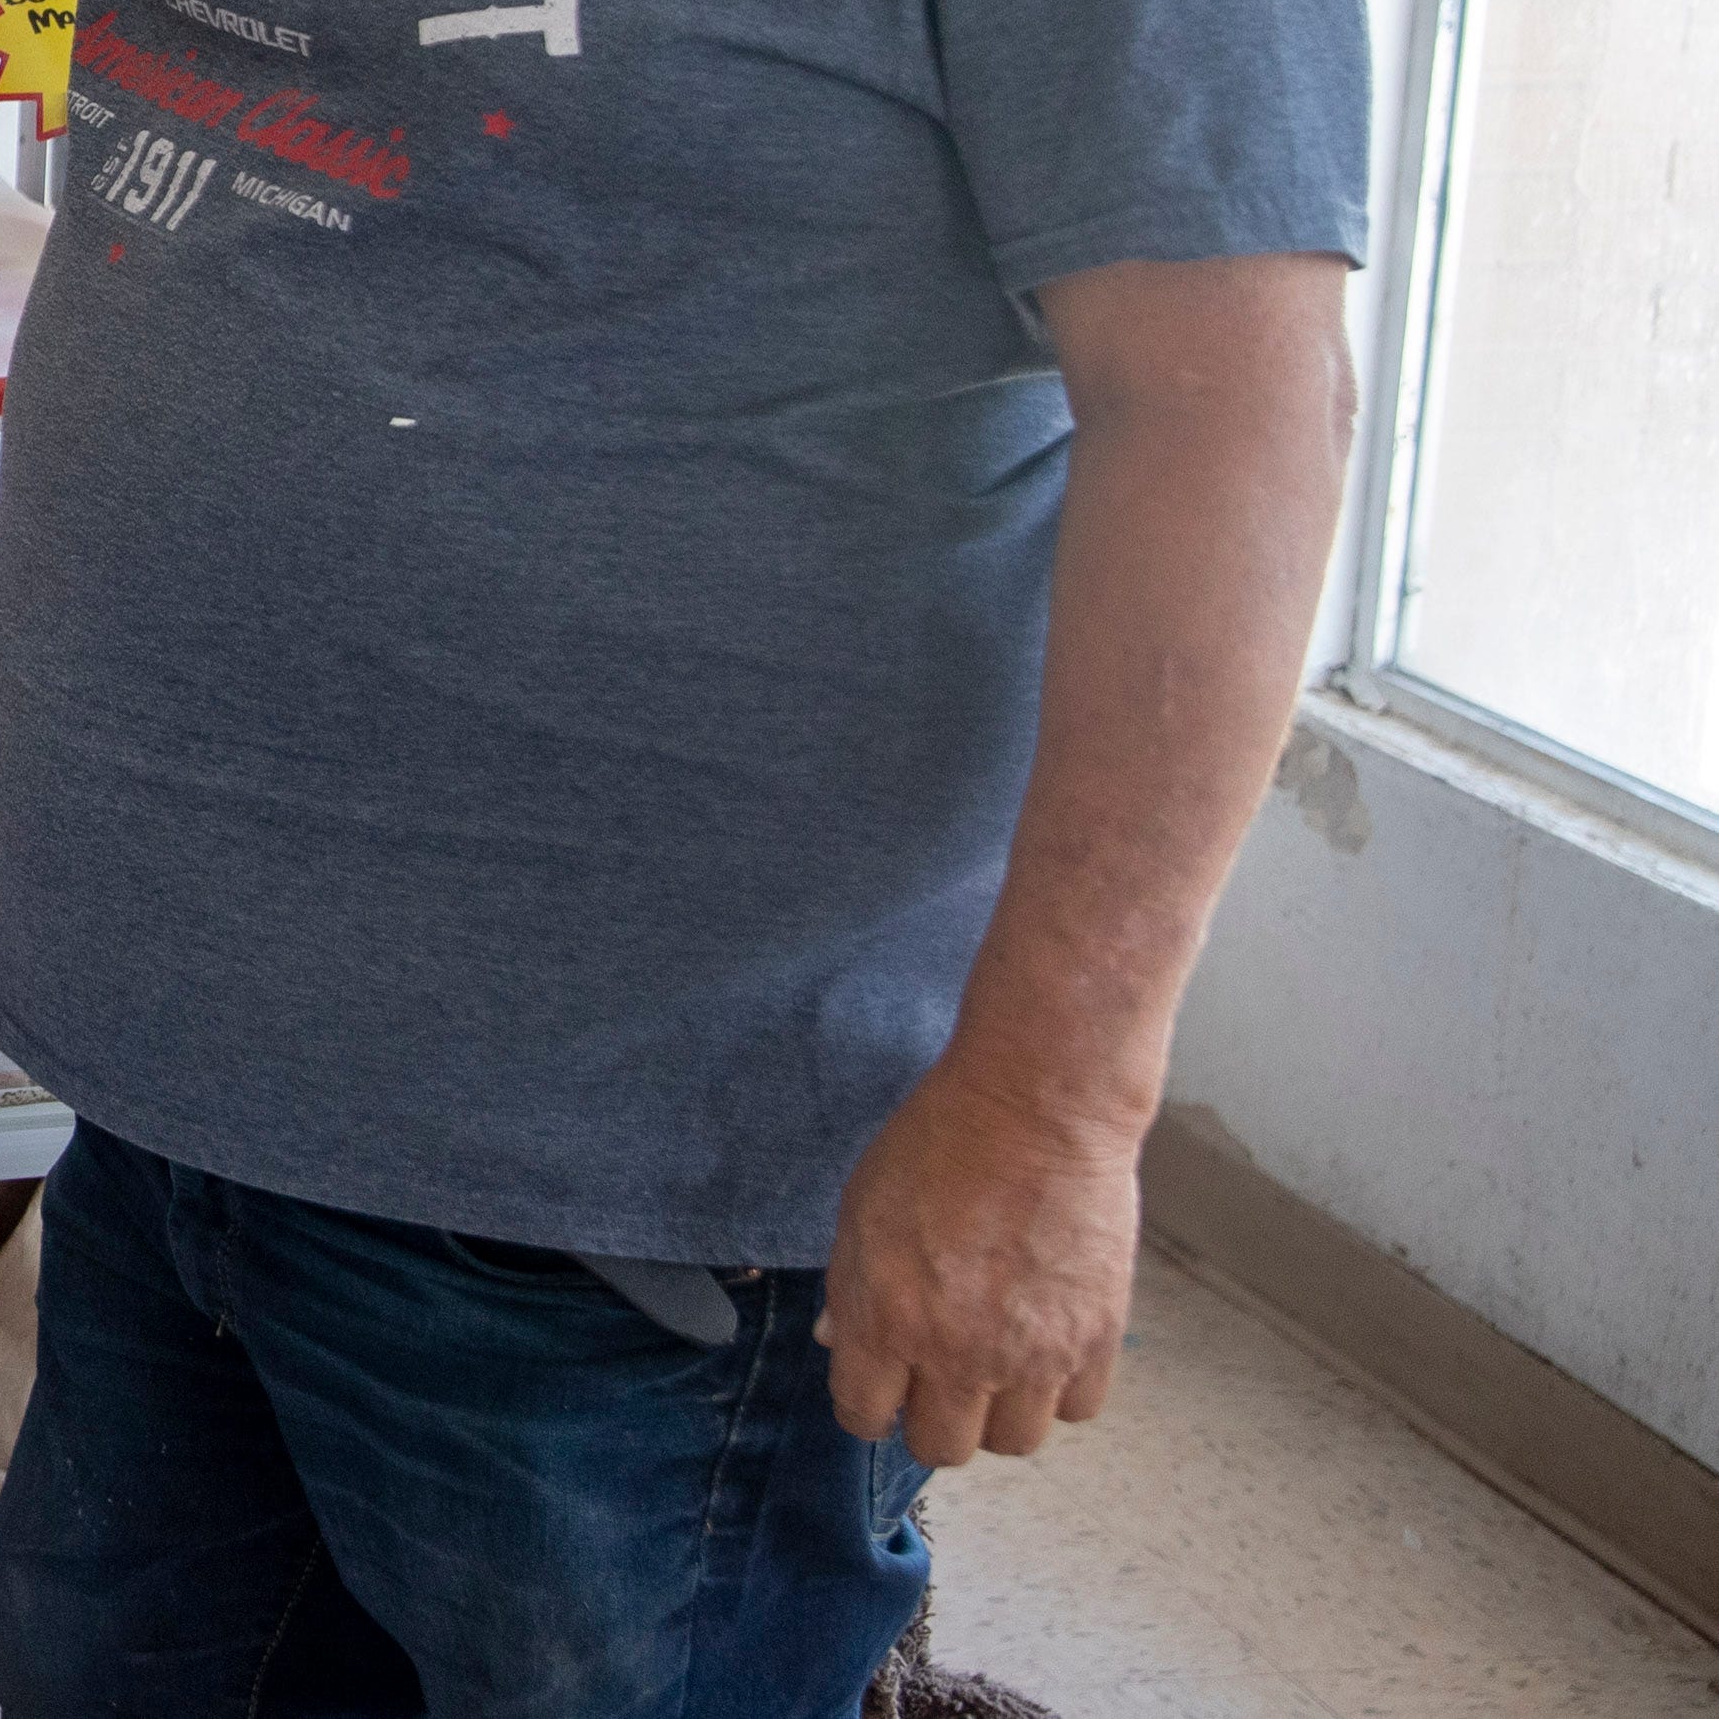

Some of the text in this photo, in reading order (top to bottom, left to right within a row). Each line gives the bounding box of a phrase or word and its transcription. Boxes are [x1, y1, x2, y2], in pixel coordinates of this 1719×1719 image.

[66, 90, 116, 129] TROIT
[74, 11, 411, 200] American Classic
[104, 129, 217, 232] 1911
[230, 170, 353, 232] MICHIGAN
